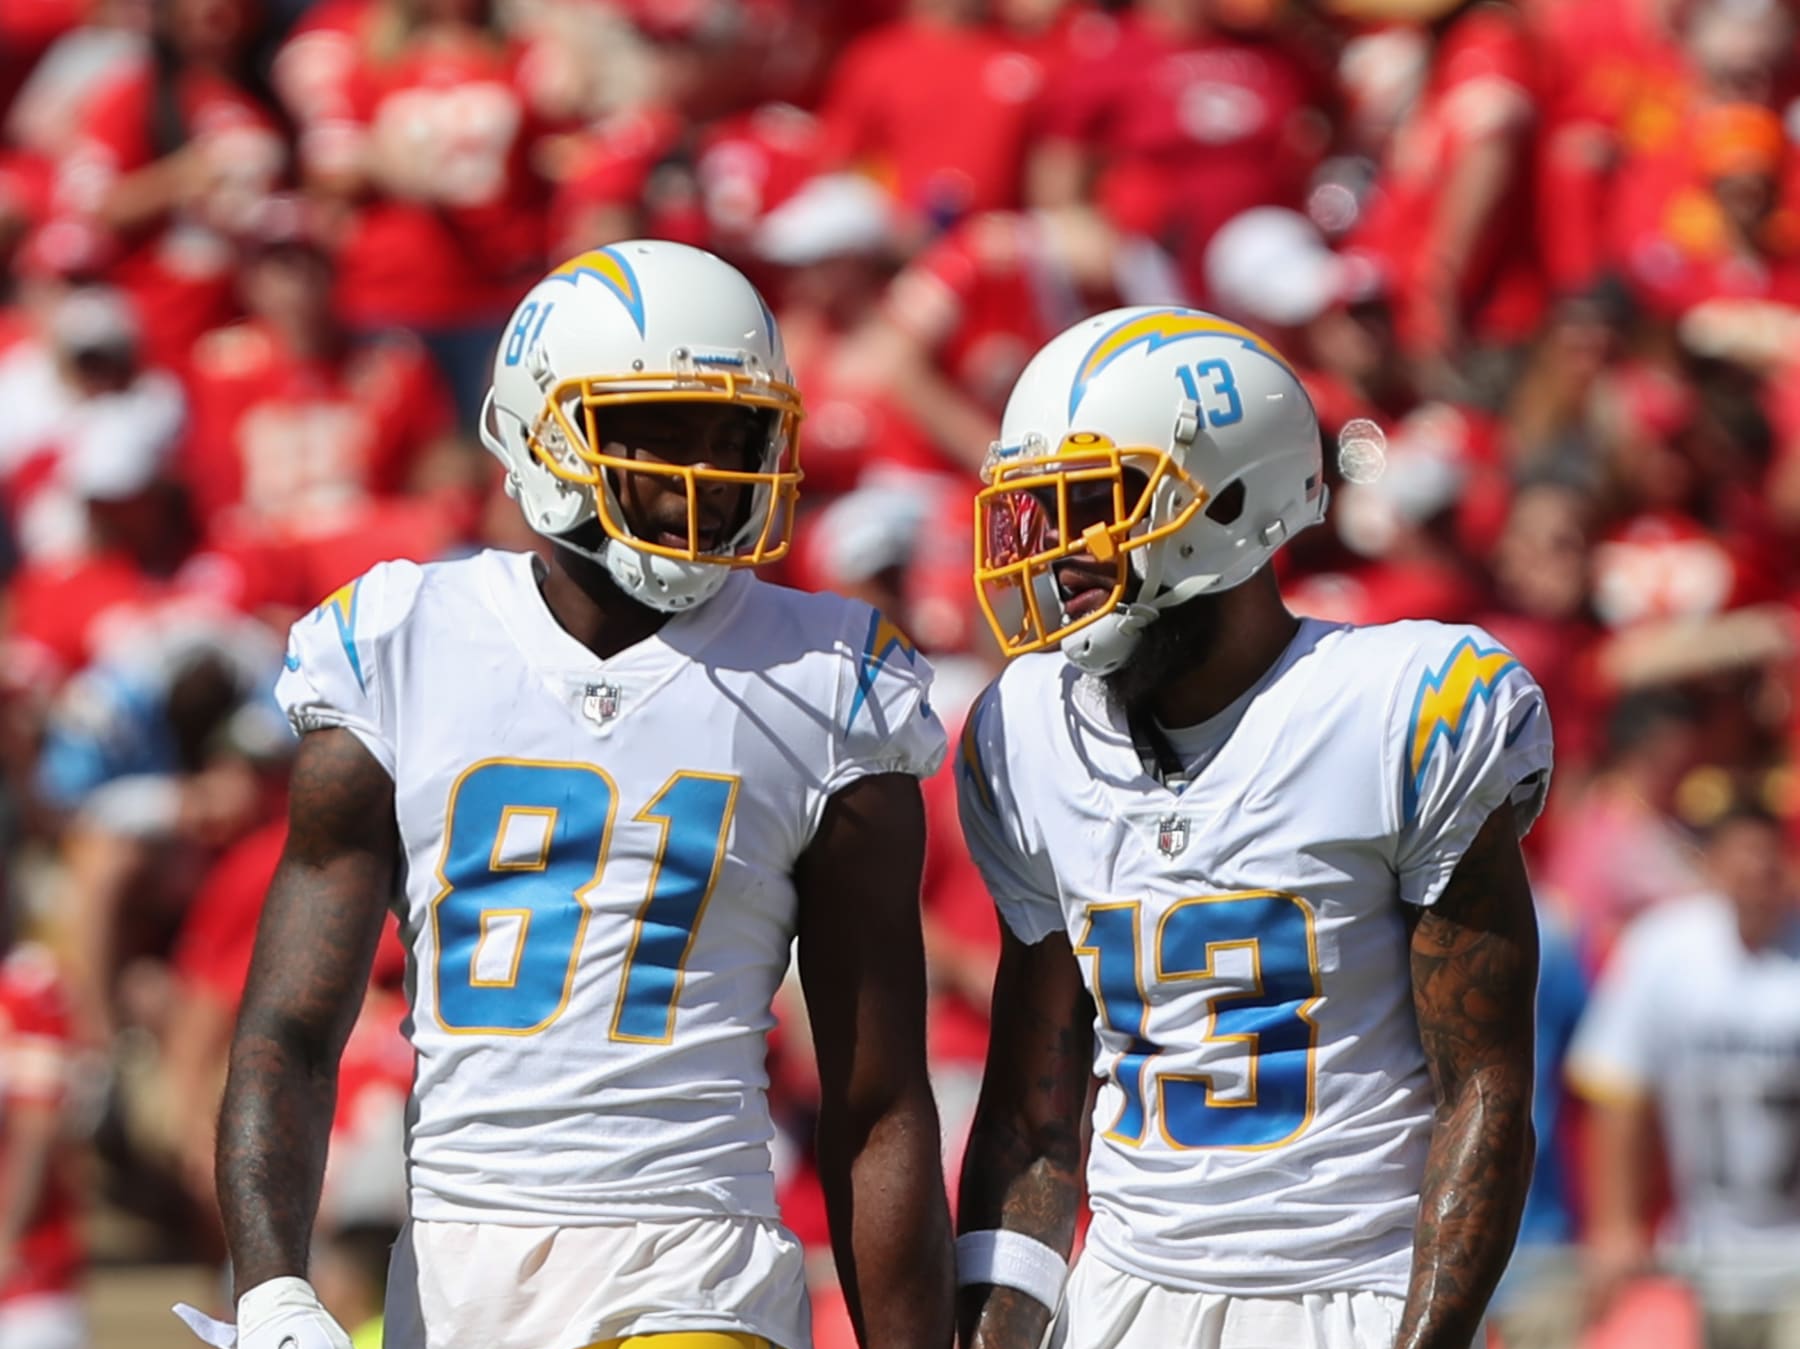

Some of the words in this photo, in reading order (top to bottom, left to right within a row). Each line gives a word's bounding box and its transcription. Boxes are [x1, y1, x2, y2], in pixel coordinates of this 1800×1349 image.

[505, 302, 555, 366] 81
[1175, 358, 1243, 429] 13
[431, 757, 742, 1045] 81
[1073, 888, 1323, 1152] 13
